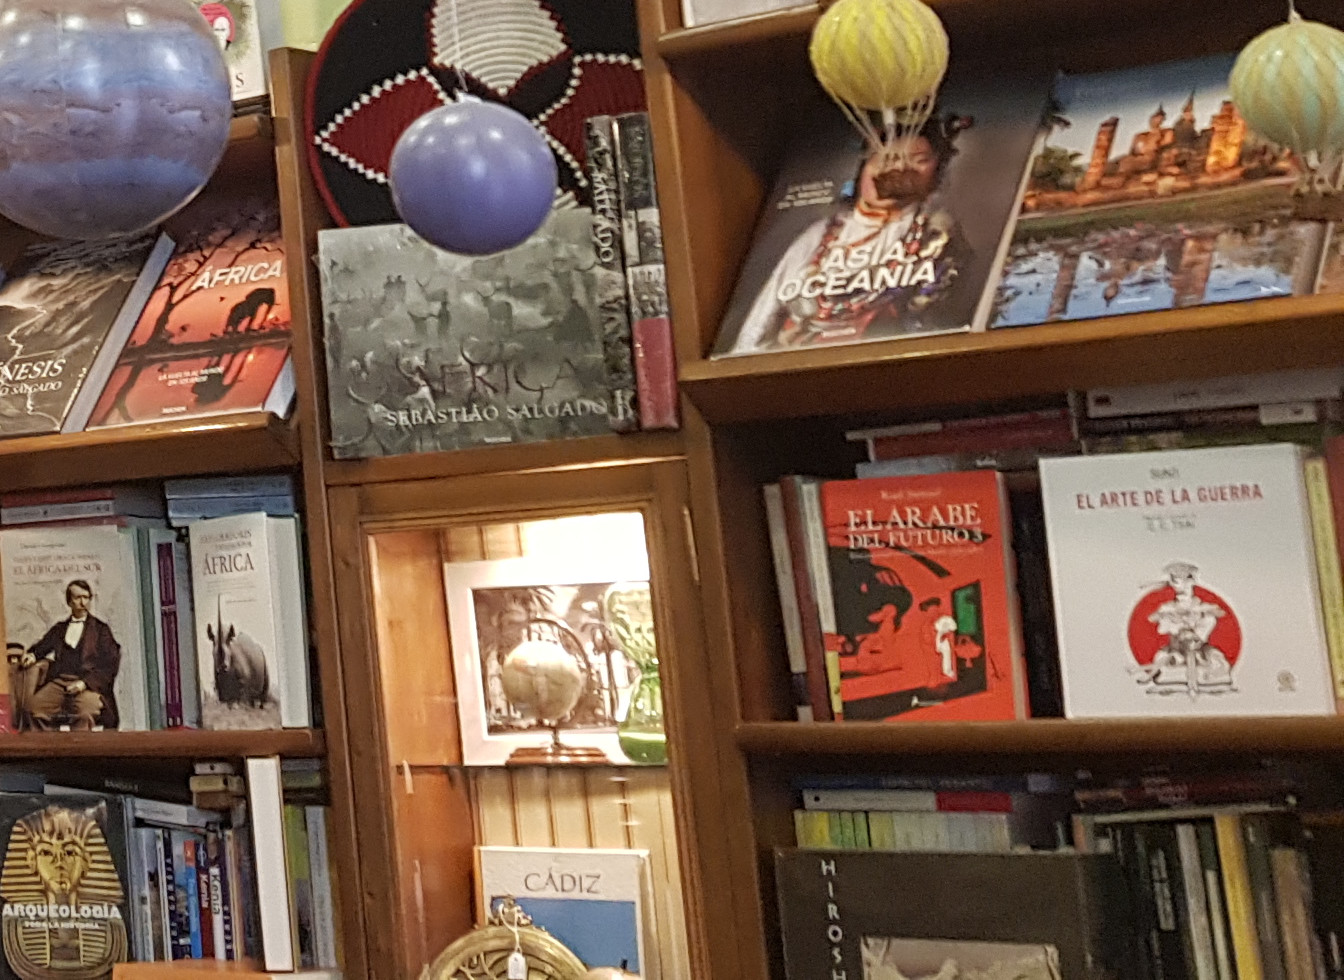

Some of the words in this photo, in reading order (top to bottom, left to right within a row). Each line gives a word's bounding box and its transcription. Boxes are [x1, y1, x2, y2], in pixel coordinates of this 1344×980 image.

[191, 259, 283, 291] ÁFRICA
[10, 380, 63, 395] SALGADO
[387, 404, 499, 427] SEBASTIÃO
[506, 397, 608, 419] SALGADO
[1076, 493, 1095, 509] EL
[1100, 490, 1139, 507] ARTE
[1144, 489, 1165, 506] DE
[1171, 487, 1191, 504] LA
[1197, 483, 1264, 502] GUERRA
[848, 509, 883, 531] EL
[849, 532, 885, 549] DEL
[888, 529, 969, 547] FUTURO
[973, 528, 983, 544] 3
[203, 552, 254, 576] ÁFRICA
[524, 866, 602, 895] CÁDIZ
